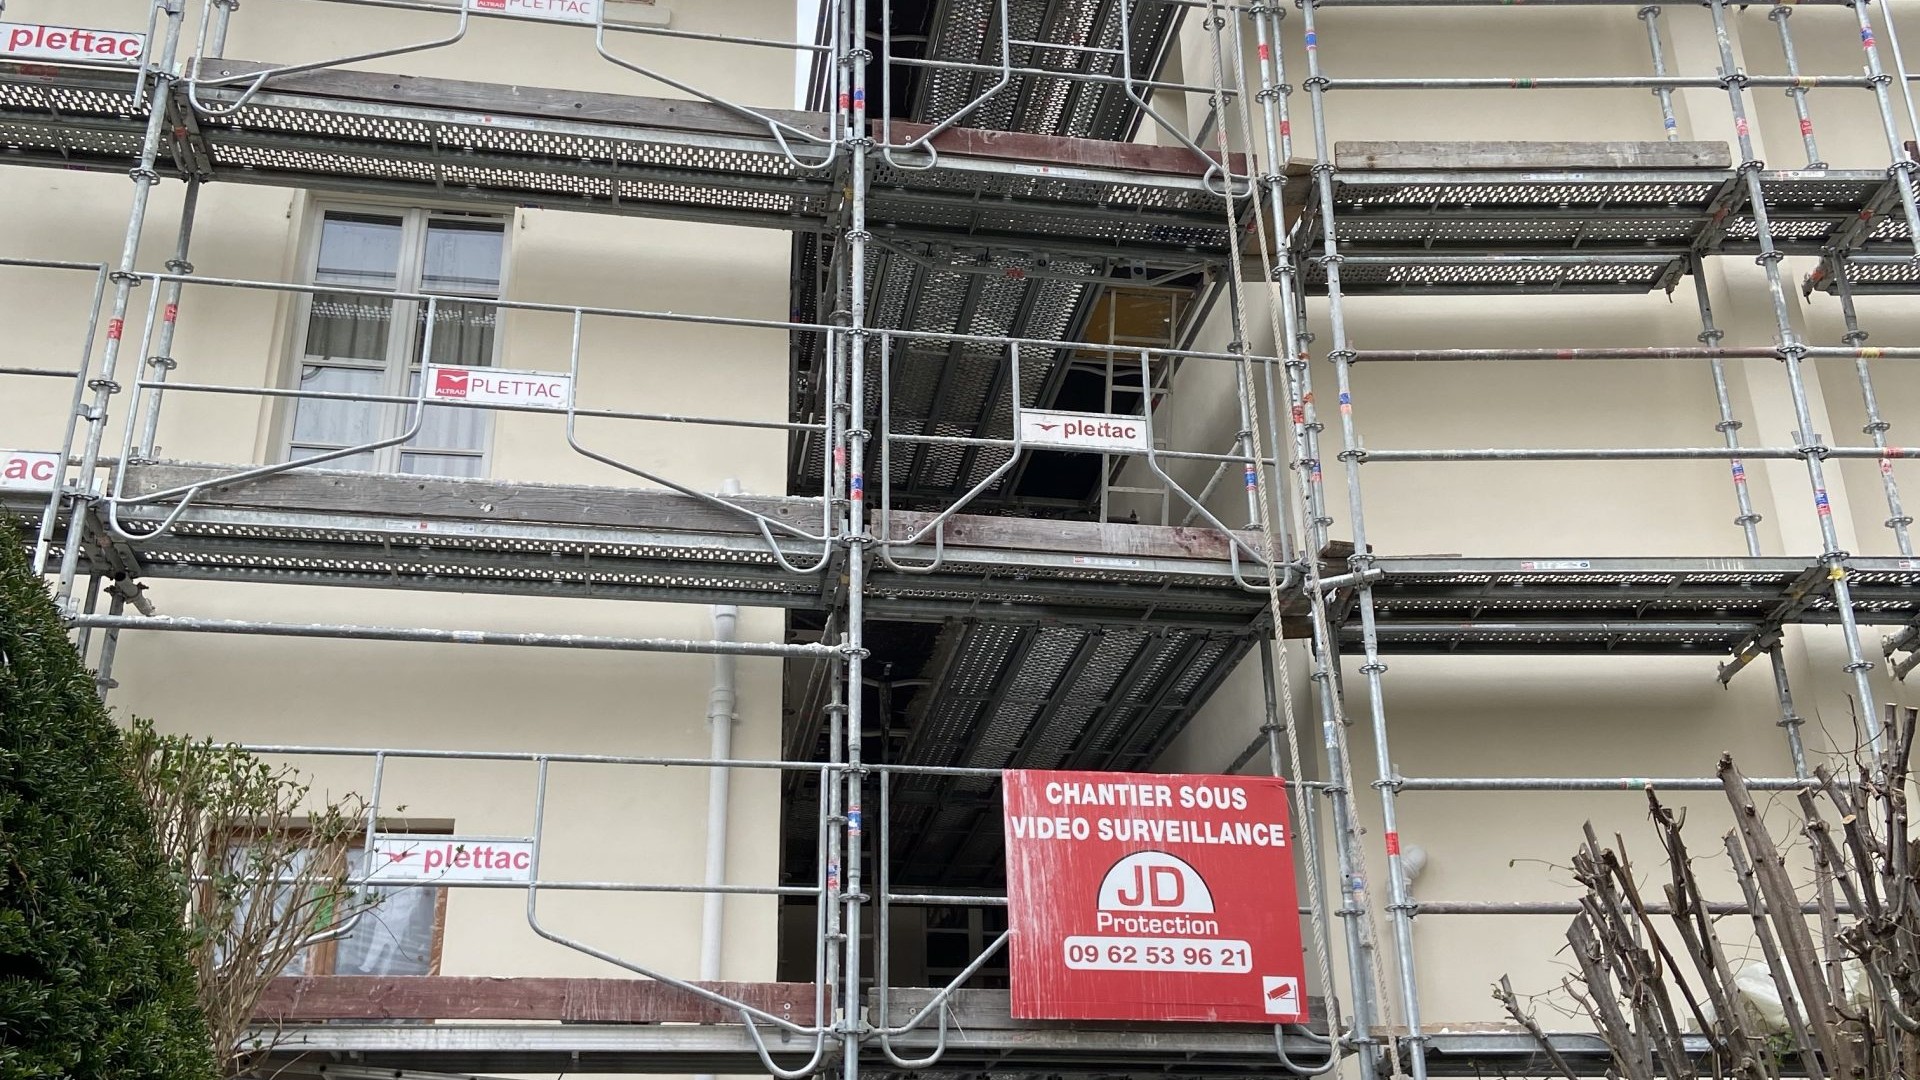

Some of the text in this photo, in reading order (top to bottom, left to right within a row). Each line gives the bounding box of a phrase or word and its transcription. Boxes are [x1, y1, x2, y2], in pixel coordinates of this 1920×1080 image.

[8, 25, 140, 56] plettac
[436, 387, 466, 396] ALTRAD
[471, 378, 561, 398] PLETTAC
[1064, 419, 1137, 439] plettac
[1045, 782, 1248, 810] CHANTIER SOUS
[1011, 816, 1286, 847] VIDEO SURVEILLANCE
[423, 844, 531, 874] plettac
[1117, 865, 1185, 907] JD
[1096, 912, 1219, 936] Protection
[1069, 945, 1246, 967] 09 62 53 96 21
